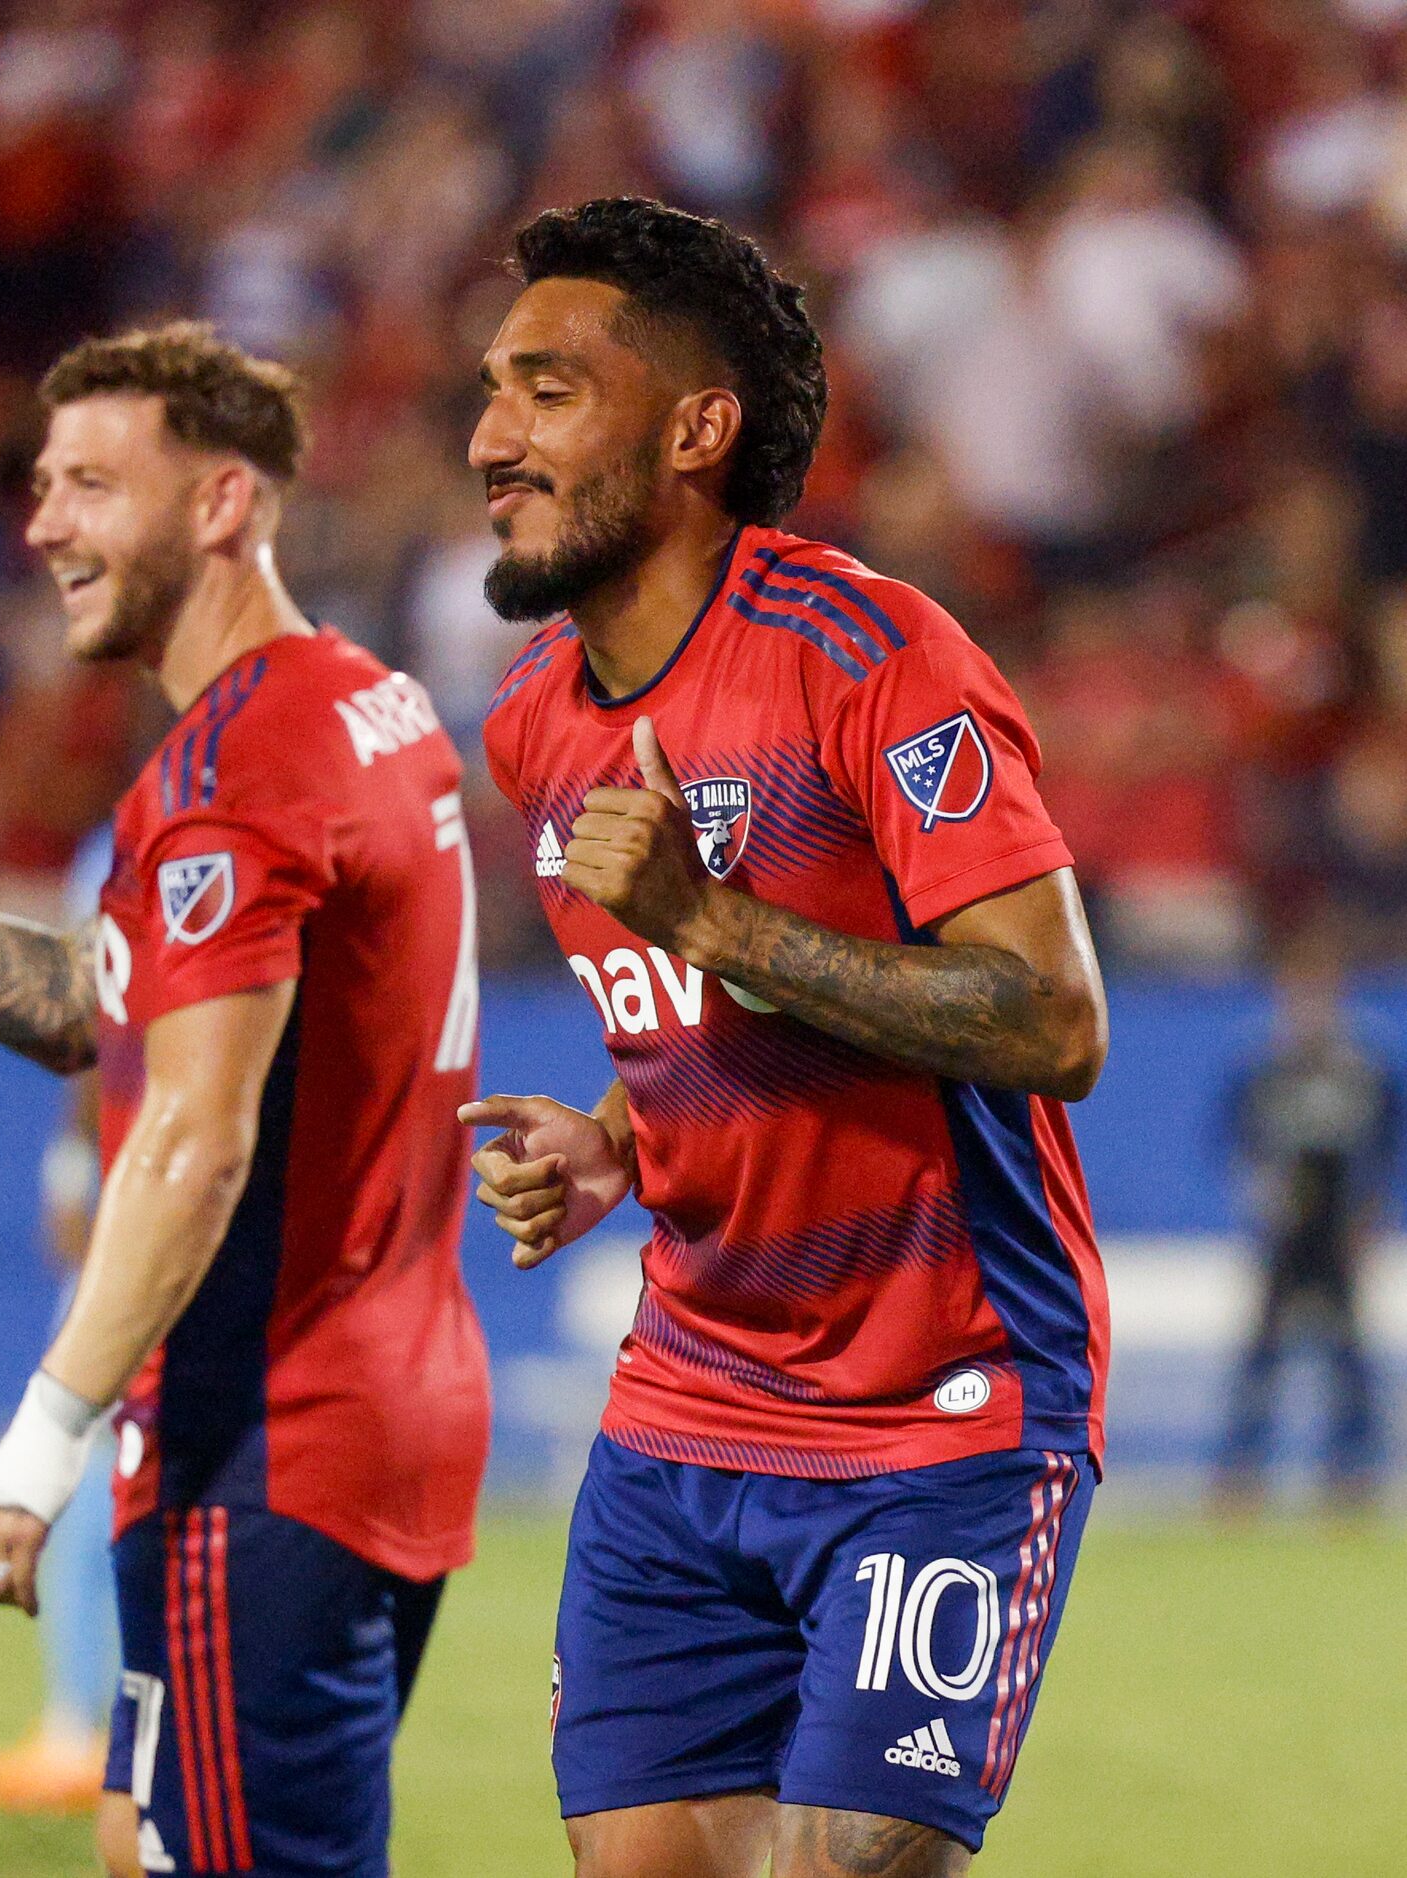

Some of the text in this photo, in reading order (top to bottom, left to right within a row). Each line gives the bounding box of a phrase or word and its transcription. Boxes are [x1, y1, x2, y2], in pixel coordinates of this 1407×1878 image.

[897, 737, 945, 774] MLS
[703, 784, 745, 808] DALLAS
[709, 810, 722, 818] 96
[536, 856, 568, 877] adida
[948, 1384, 976, 1402] LH
[854, 1552, 1000, 1700] 10
[884, 1747, 961, 1777] adidas
